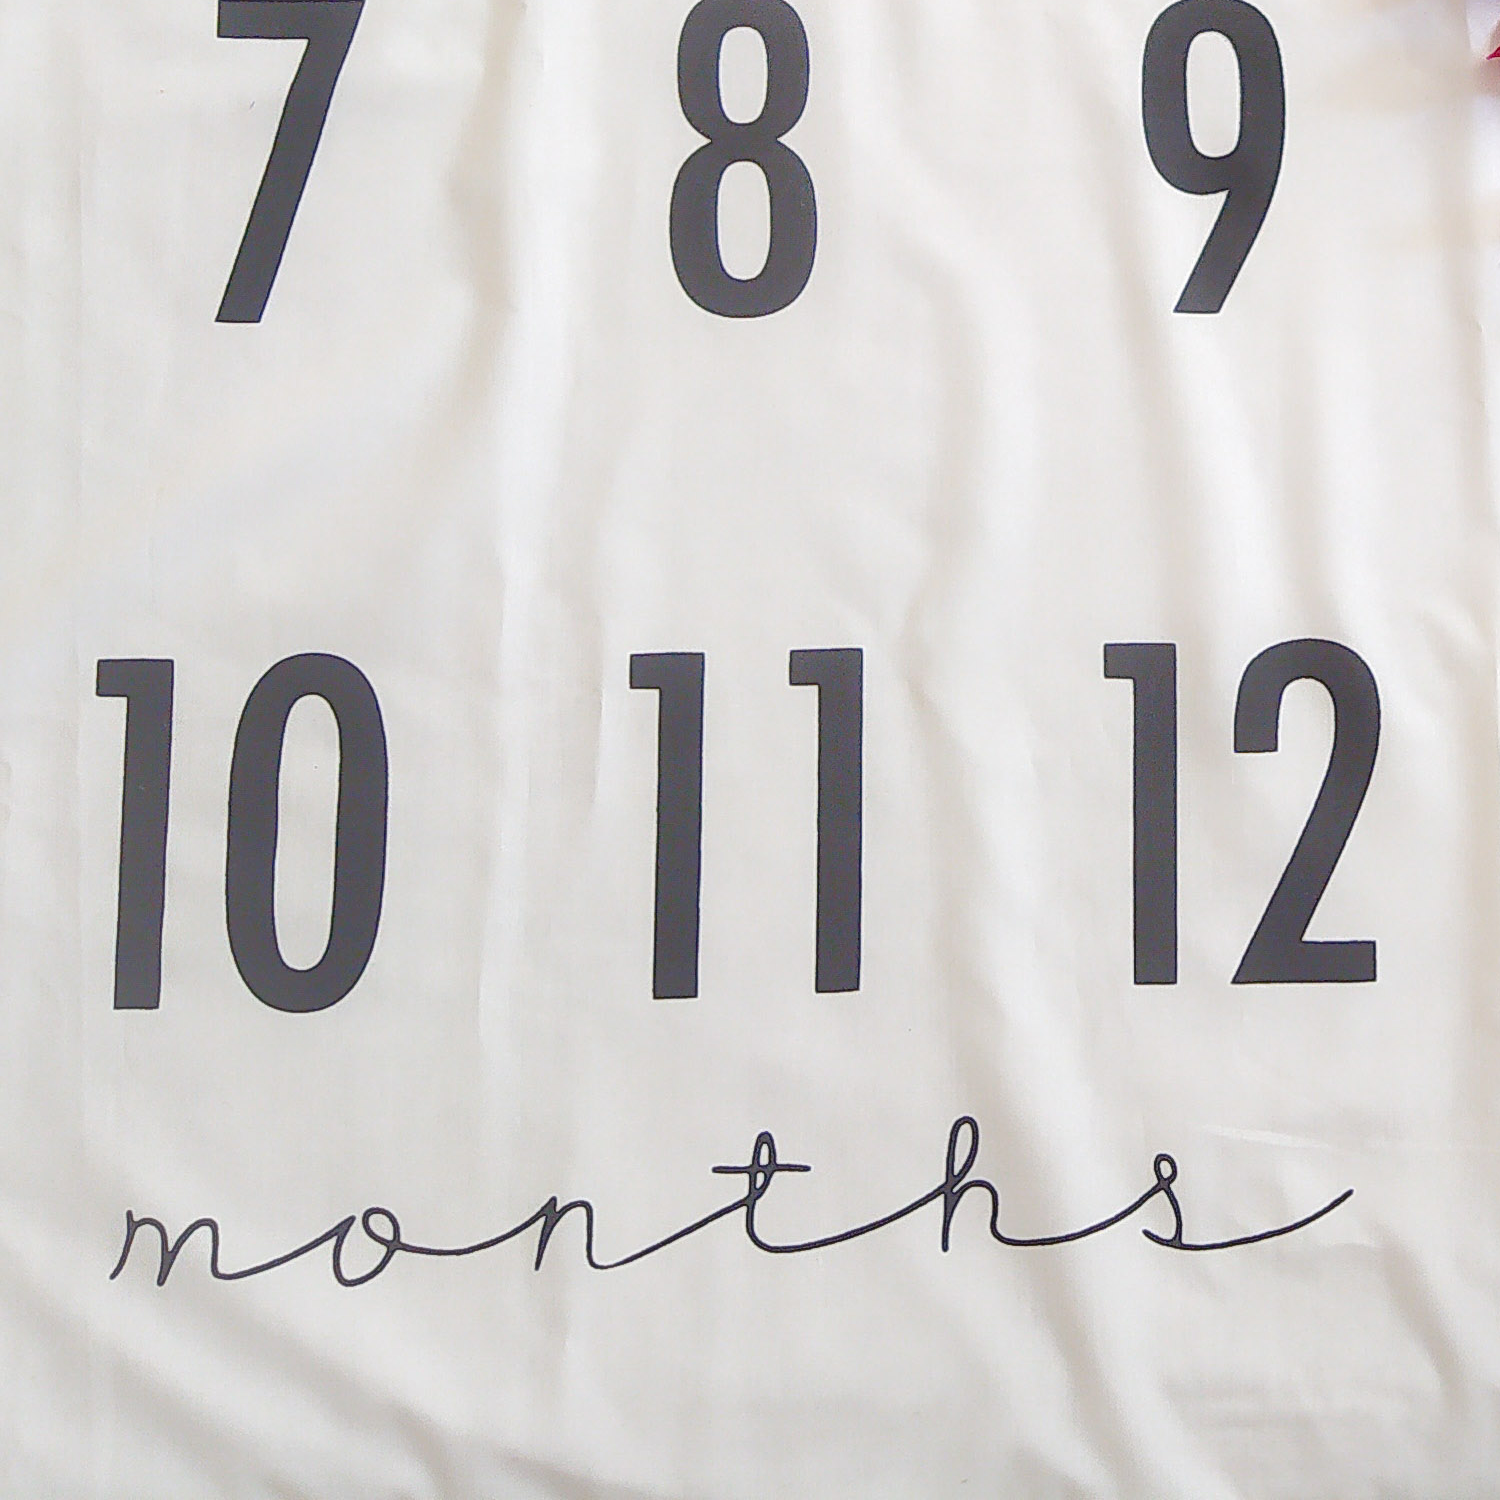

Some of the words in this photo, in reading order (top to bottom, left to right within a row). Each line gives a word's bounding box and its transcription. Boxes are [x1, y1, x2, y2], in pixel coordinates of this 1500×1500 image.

[95, 652, 389, 1014] 10
[629, 647, 864, 1000] 11
[1103, 637, 1382, 986] 12
[109, 1115, 1354, 1288] months
